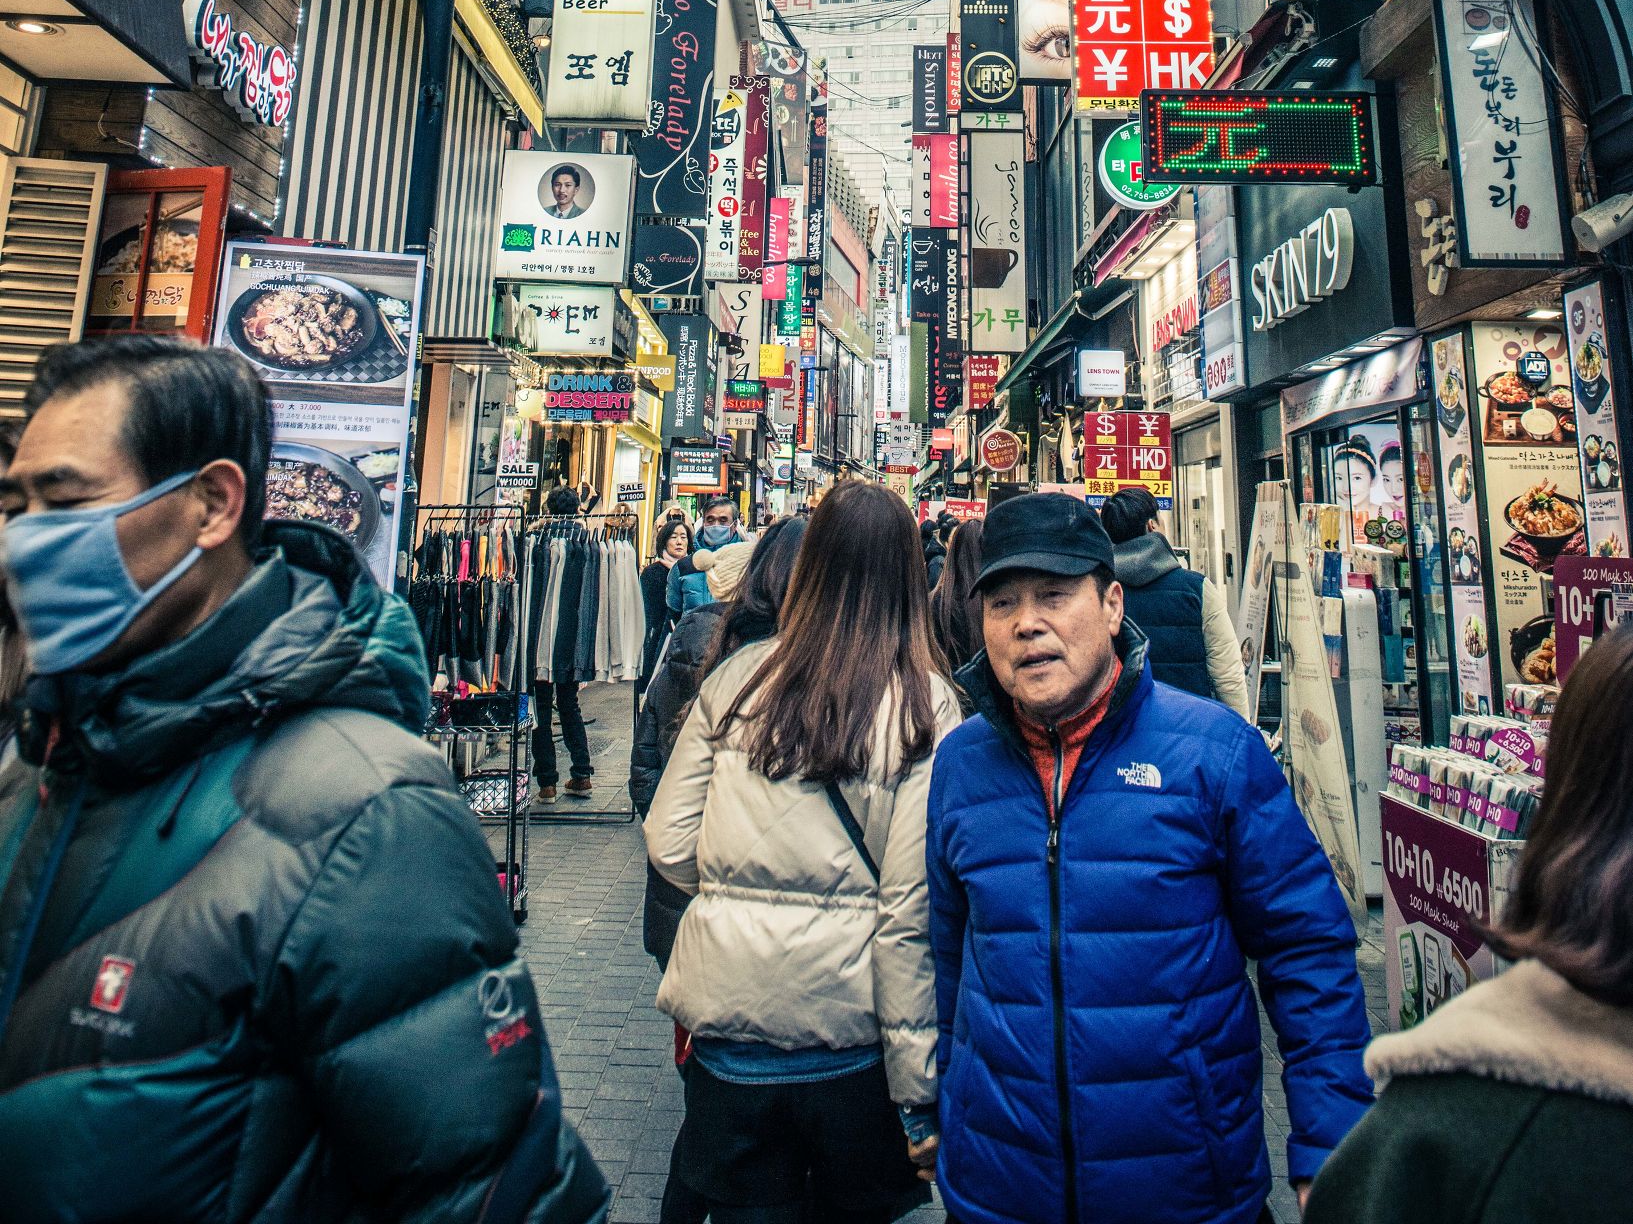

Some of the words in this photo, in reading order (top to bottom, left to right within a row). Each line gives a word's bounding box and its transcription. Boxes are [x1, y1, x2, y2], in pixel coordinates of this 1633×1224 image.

[565, 50, 634, 86] 포엠
[1092, 49, 1128, 91] ¥
[975, 112, 1010, 128] 가무
[720, 158, 739, 255] 즉석떡볶이
[541, 229, 620, 248] RIAHN
[740, 230, 759, 238] ffee
[947, 248, 957, 286] DONG
[1251, 208, 1353, 331] SKIN79
[947, 287, 957, 339] MYEONG
[973, 308, 1025, 332] 가무
[1153, 313, 1170, 352] LENS
[1172, 293, 1197, 335] TOWN
[688, 339, 698, 361] Pizza
[640, 366, 671, 375] NFOOD
[1527, 359, 1547, 374] ADT
[549, 375, 613, 391] DRINK
[617, 376, 632, 392] &
[545, 392, 633, 408] DESSERT
[548, 409, 592, 420] 모든음료에
[1097, 413, 1116, 435] $
[1139, 415, 1159, 436] ¥
[1096, 448, 1118, 469] 元
[1133, 448, 1167, 470] HKD
[501, 465, 534, 474] SALE
[500, 478, 533, 487] ₩10000
[1153, 483, 1169, 494] 2F
[1583, 568, 1599, 580] 100
[1601, 568, 1621, 583] Mask
[1623, 571, 1633, 583] Sh
[1505, 730, 1531, 750] 10+10
[1117, 768, 1146, 777] NORTH
[1131, 762, 1147, 770] THE
[1125, 776, 1147, 785] FACE
[1386, 830, 1434, 894] 10+10
[1409, 893, 1422, 911] 100
[1424, 902, 1441, 922] Mask
